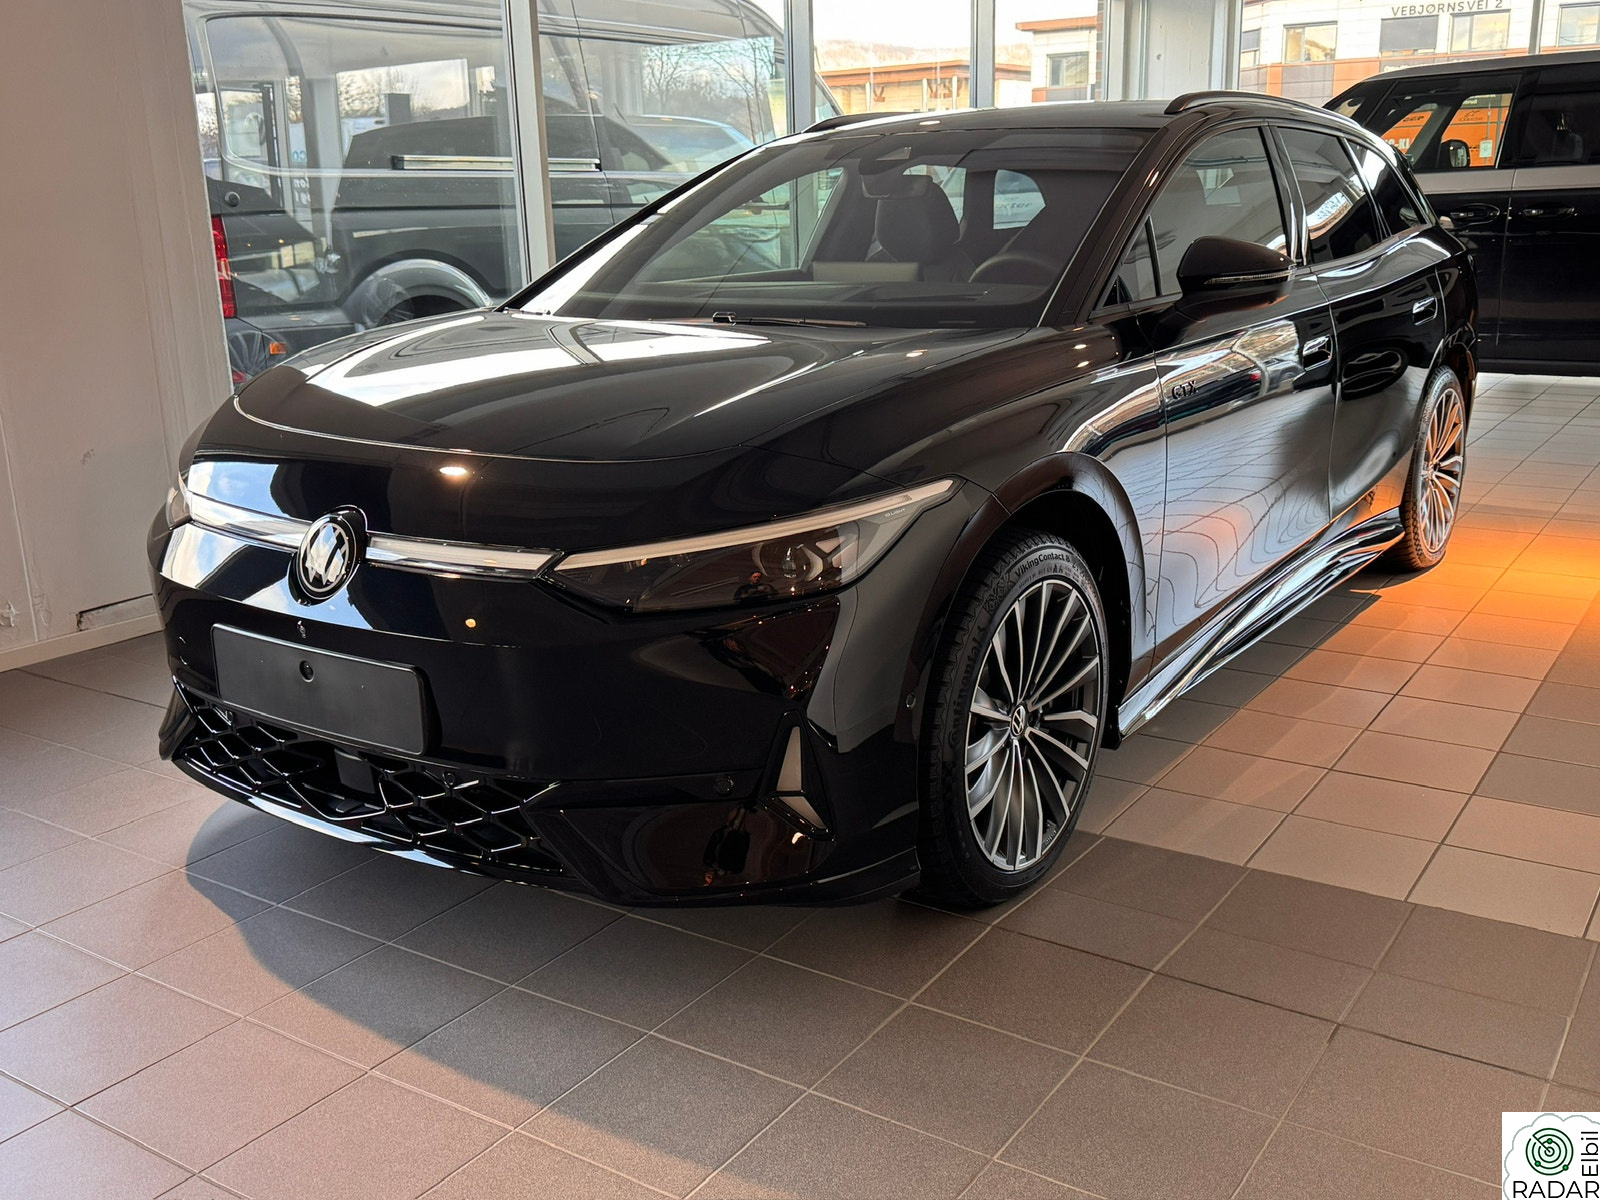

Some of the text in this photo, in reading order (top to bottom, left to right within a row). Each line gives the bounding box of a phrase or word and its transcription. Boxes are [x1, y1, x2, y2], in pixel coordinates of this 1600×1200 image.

[1391, 0, 1503, 16] VEBJØRNSVEI 2
[1172, 380, 1197, 399] GTX
[1015, 552, 1065, 577] VikingContact
